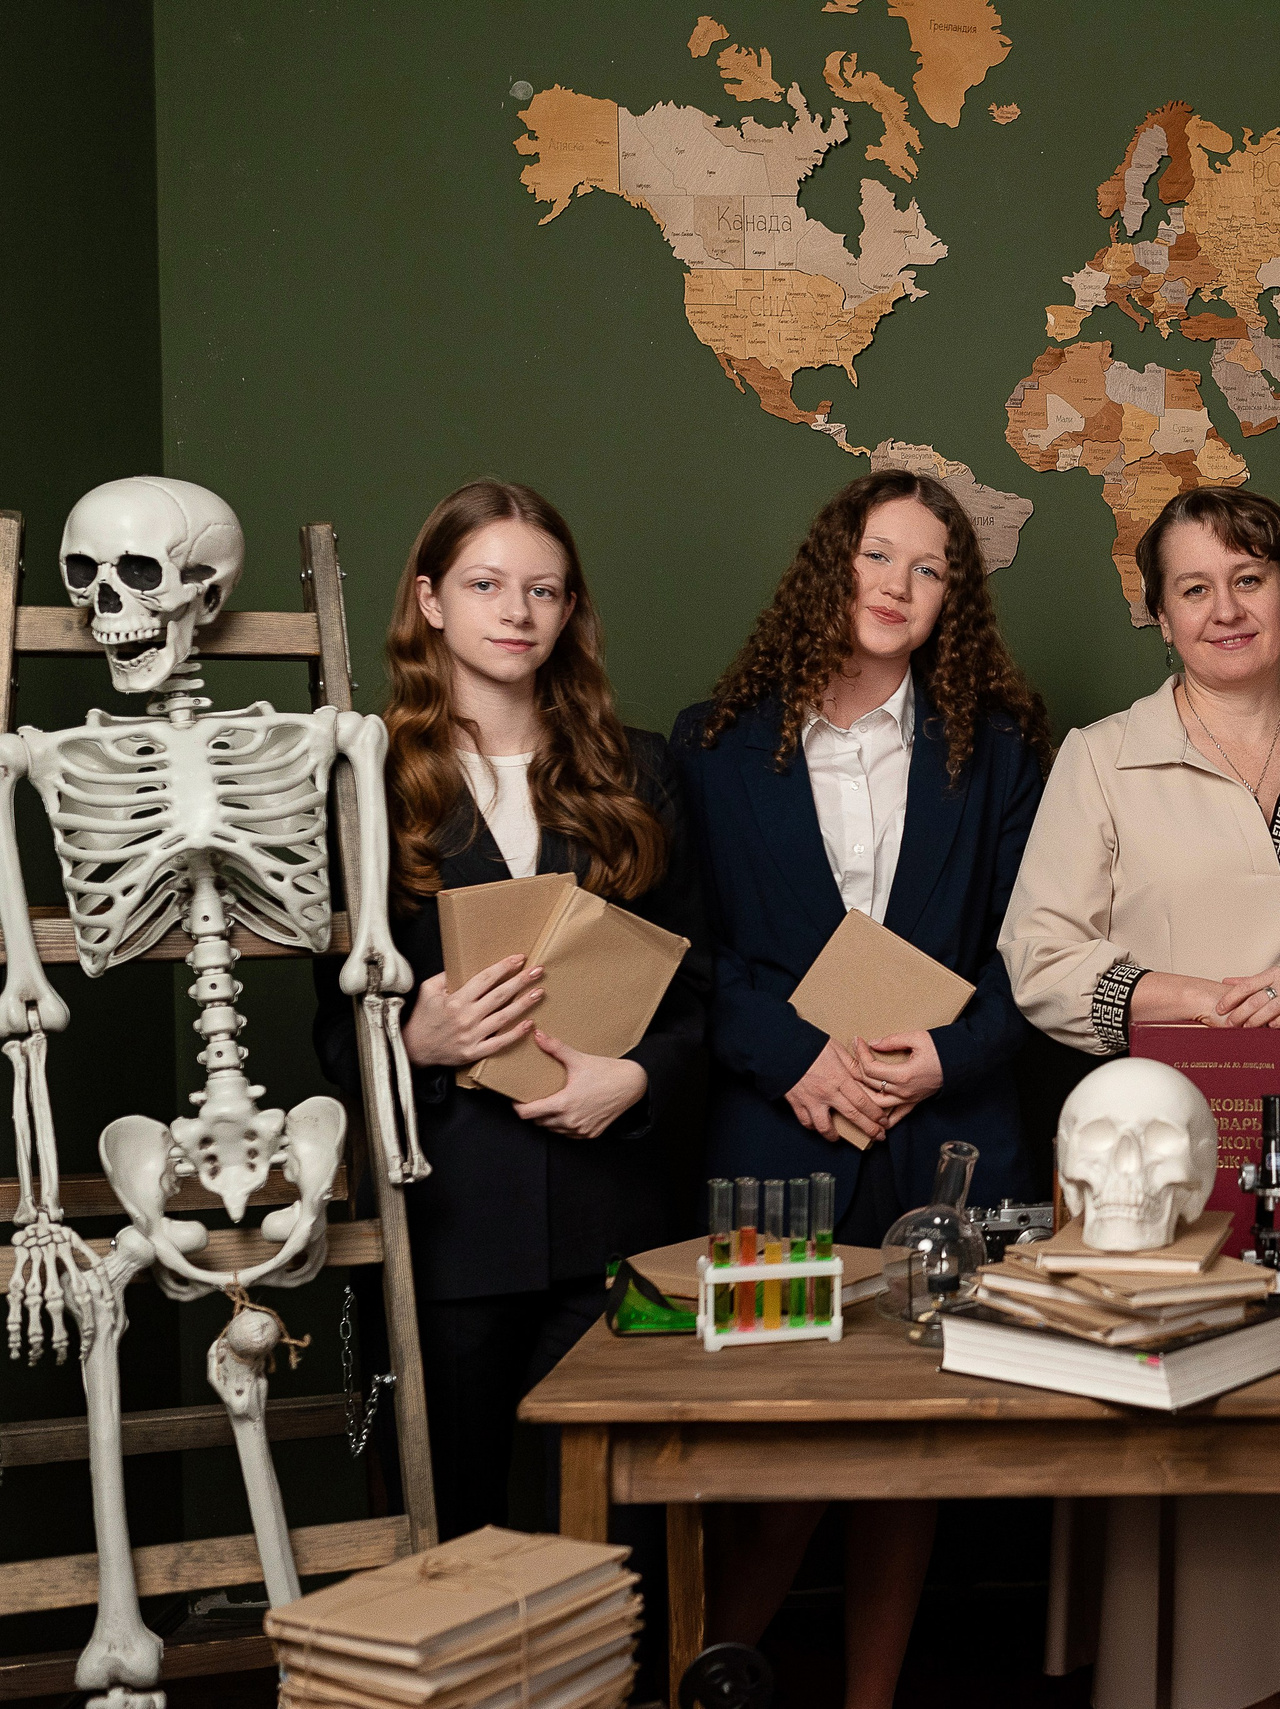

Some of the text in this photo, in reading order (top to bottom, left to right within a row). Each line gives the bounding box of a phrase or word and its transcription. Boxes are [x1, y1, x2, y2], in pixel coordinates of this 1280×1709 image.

[929, 19, 977, 34] Гренландия
[716, 205, 792, 234] Канада
[749, 296, 794, 317] США
[1055, 415, 1074, 423] Мали
